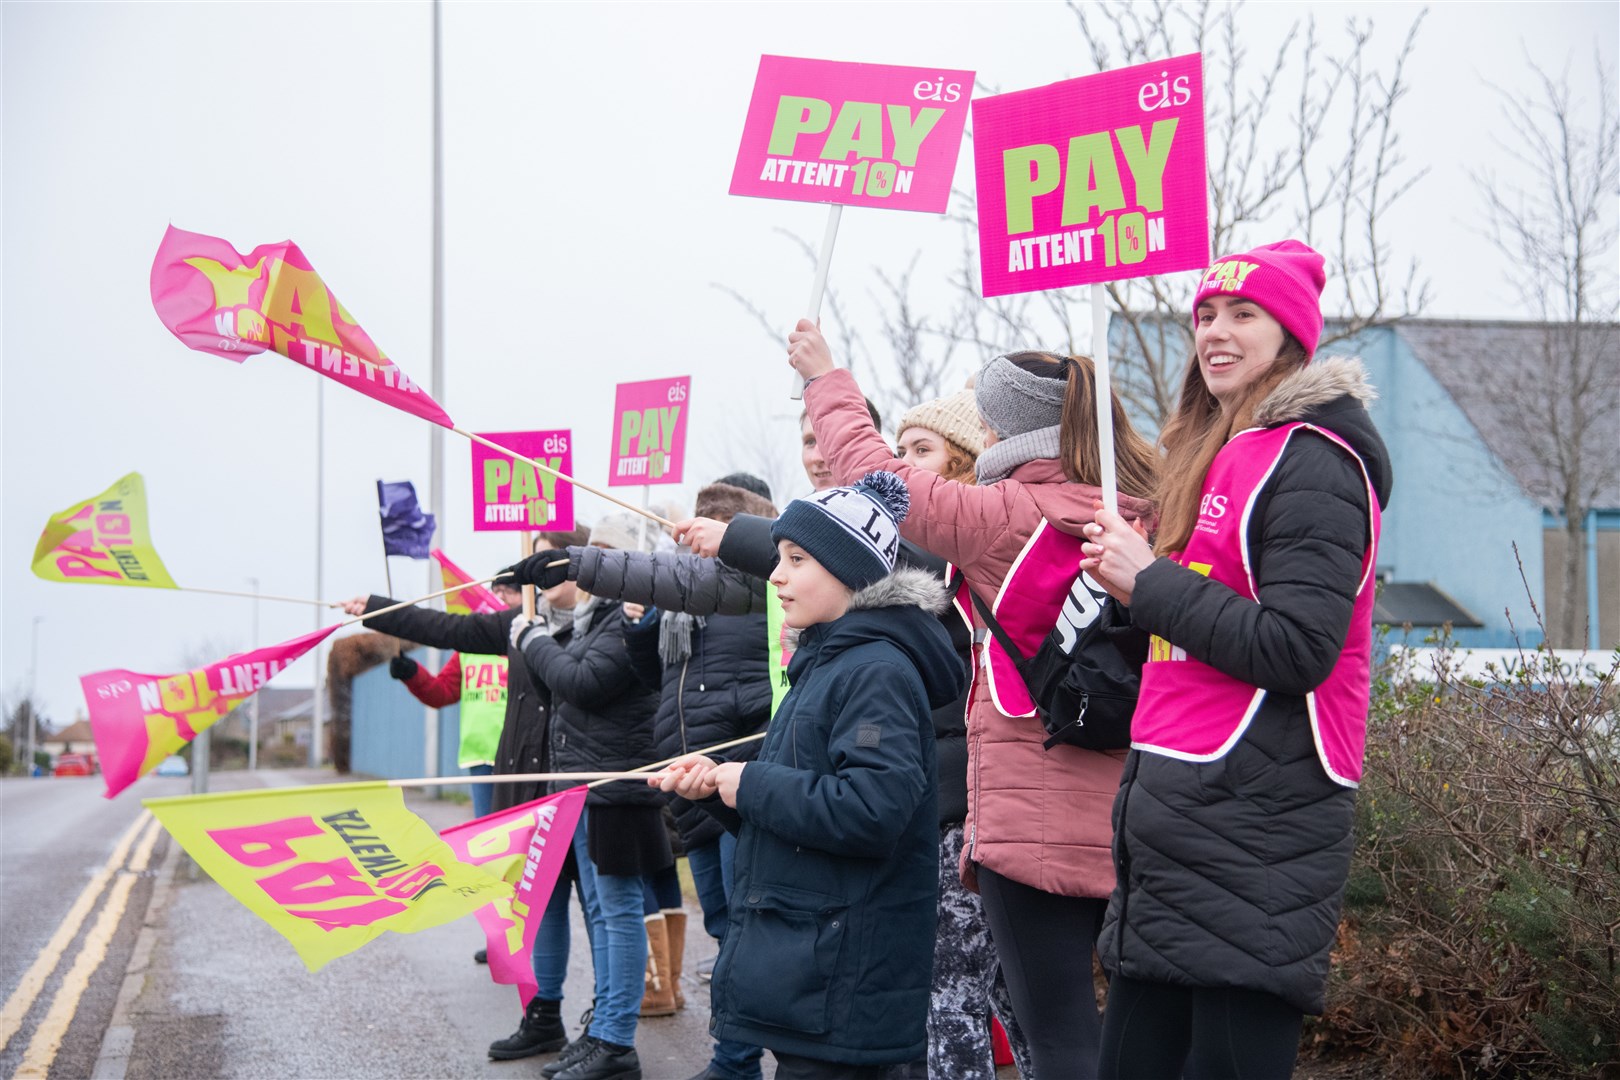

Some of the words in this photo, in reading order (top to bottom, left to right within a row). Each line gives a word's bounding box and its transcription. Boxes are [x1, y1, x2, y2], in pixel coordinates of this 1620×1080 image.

[913, 77, 961, 103] eis
[1139, 72, 1191, 112] eis
[767, 95, 946, 167] PAY
[1003, 117, 1180, 235] PAY
[1202, 260, 1260, 283] PAY
[667, 382, 687, 402] eis
[543, 434, 568, 454] eis
[618, 405, 681, 457] PAY
[483, 456, 563, 503] PAY
